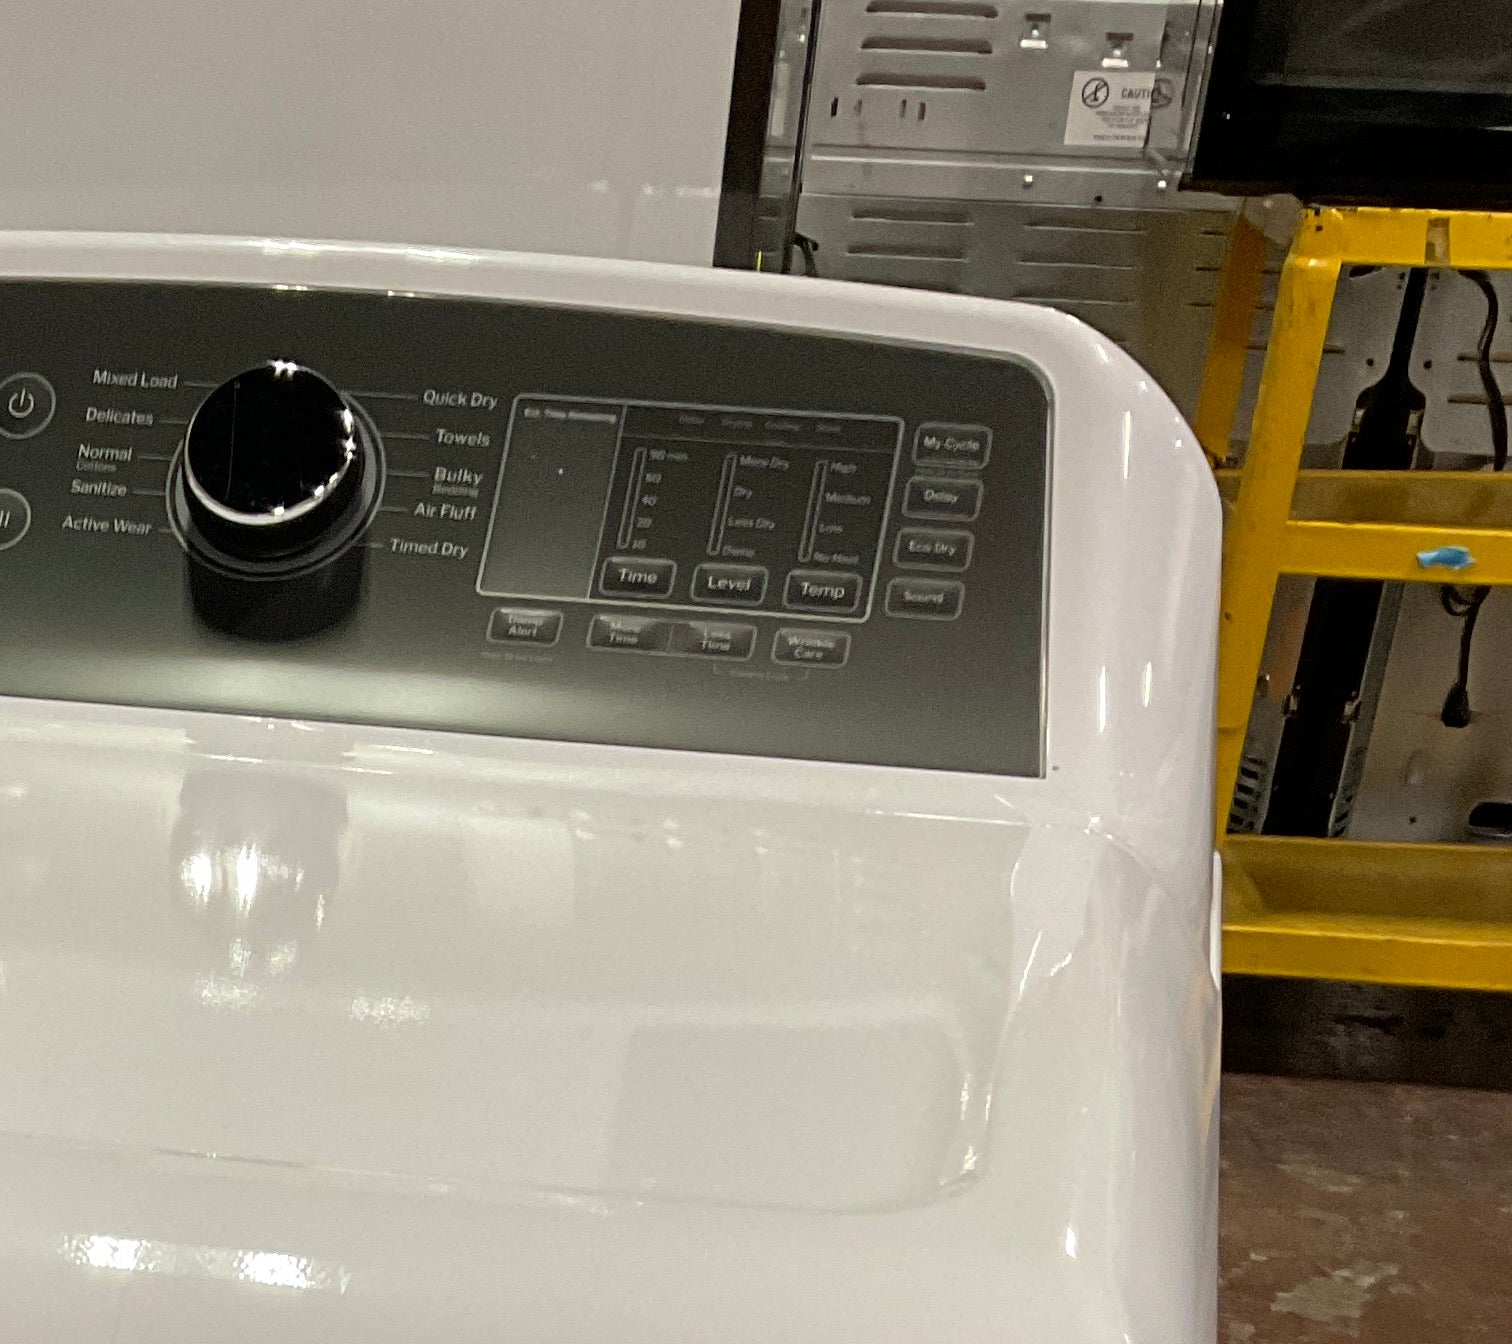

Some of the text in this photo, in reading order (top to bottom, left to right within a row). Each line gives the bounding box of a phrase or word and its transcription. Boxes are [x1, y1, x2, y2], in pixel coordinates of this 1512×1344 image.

[92, 368, 178, 390] Mixed Load
[422, 388, 499, 412] Quick Dry
[85, 406, 154, 427] Delicates
[435, 428, 491, 449] Towels
[77, 443, 133, 462] Normal
[434, 465, 484, 487] Bulky
[70, 478, 128, 497] Sanitize
[413, 501, 477, 522] Air Fluff
[61, 514, 153, 535] Active Wear
[389, 537, 470, 561] Timed Dry
[618, 566, 658, 586] Time
[707, 575, 752, 593] Level
[799, 581, 846, 602] Temp
[506, 625, 539, 639] Alert
[608, 631, 639, 646] Time
[700, 639, 731, 653] Time
[792, 647, 824, 661] Care
